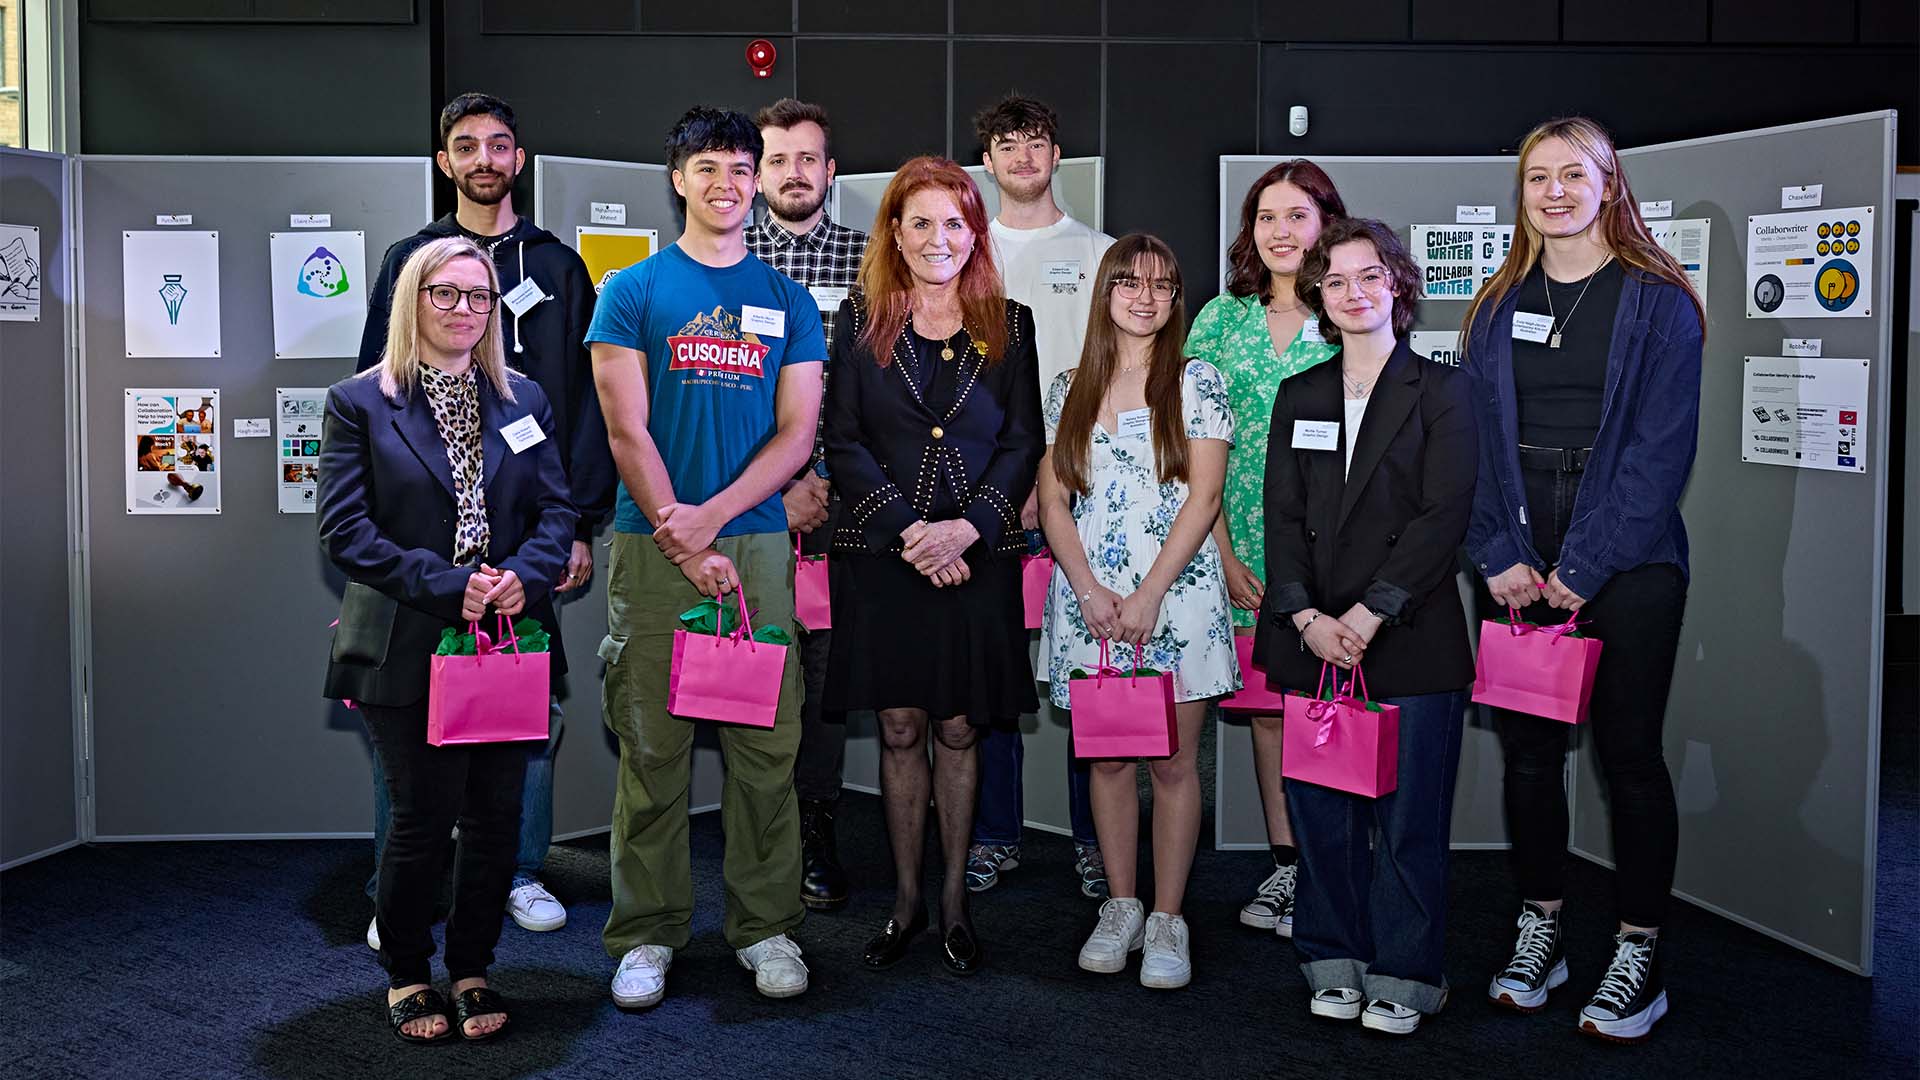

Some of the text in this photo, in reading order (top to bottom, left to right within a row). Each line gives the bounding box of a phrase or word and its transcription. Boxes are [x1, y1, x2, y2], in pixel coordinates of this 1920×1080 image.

[1482, 231, 1495, 239] CW
[1755, 224, 1808, 235] Collaborwriter
[1426, 231, 1473, 247] COLLABOR
[1426, 266, 1472, 282] COLLABOR
[677, 343, 760, 369] CUSQUEÑA
[708, 371, 740, 381] PREMIUM
